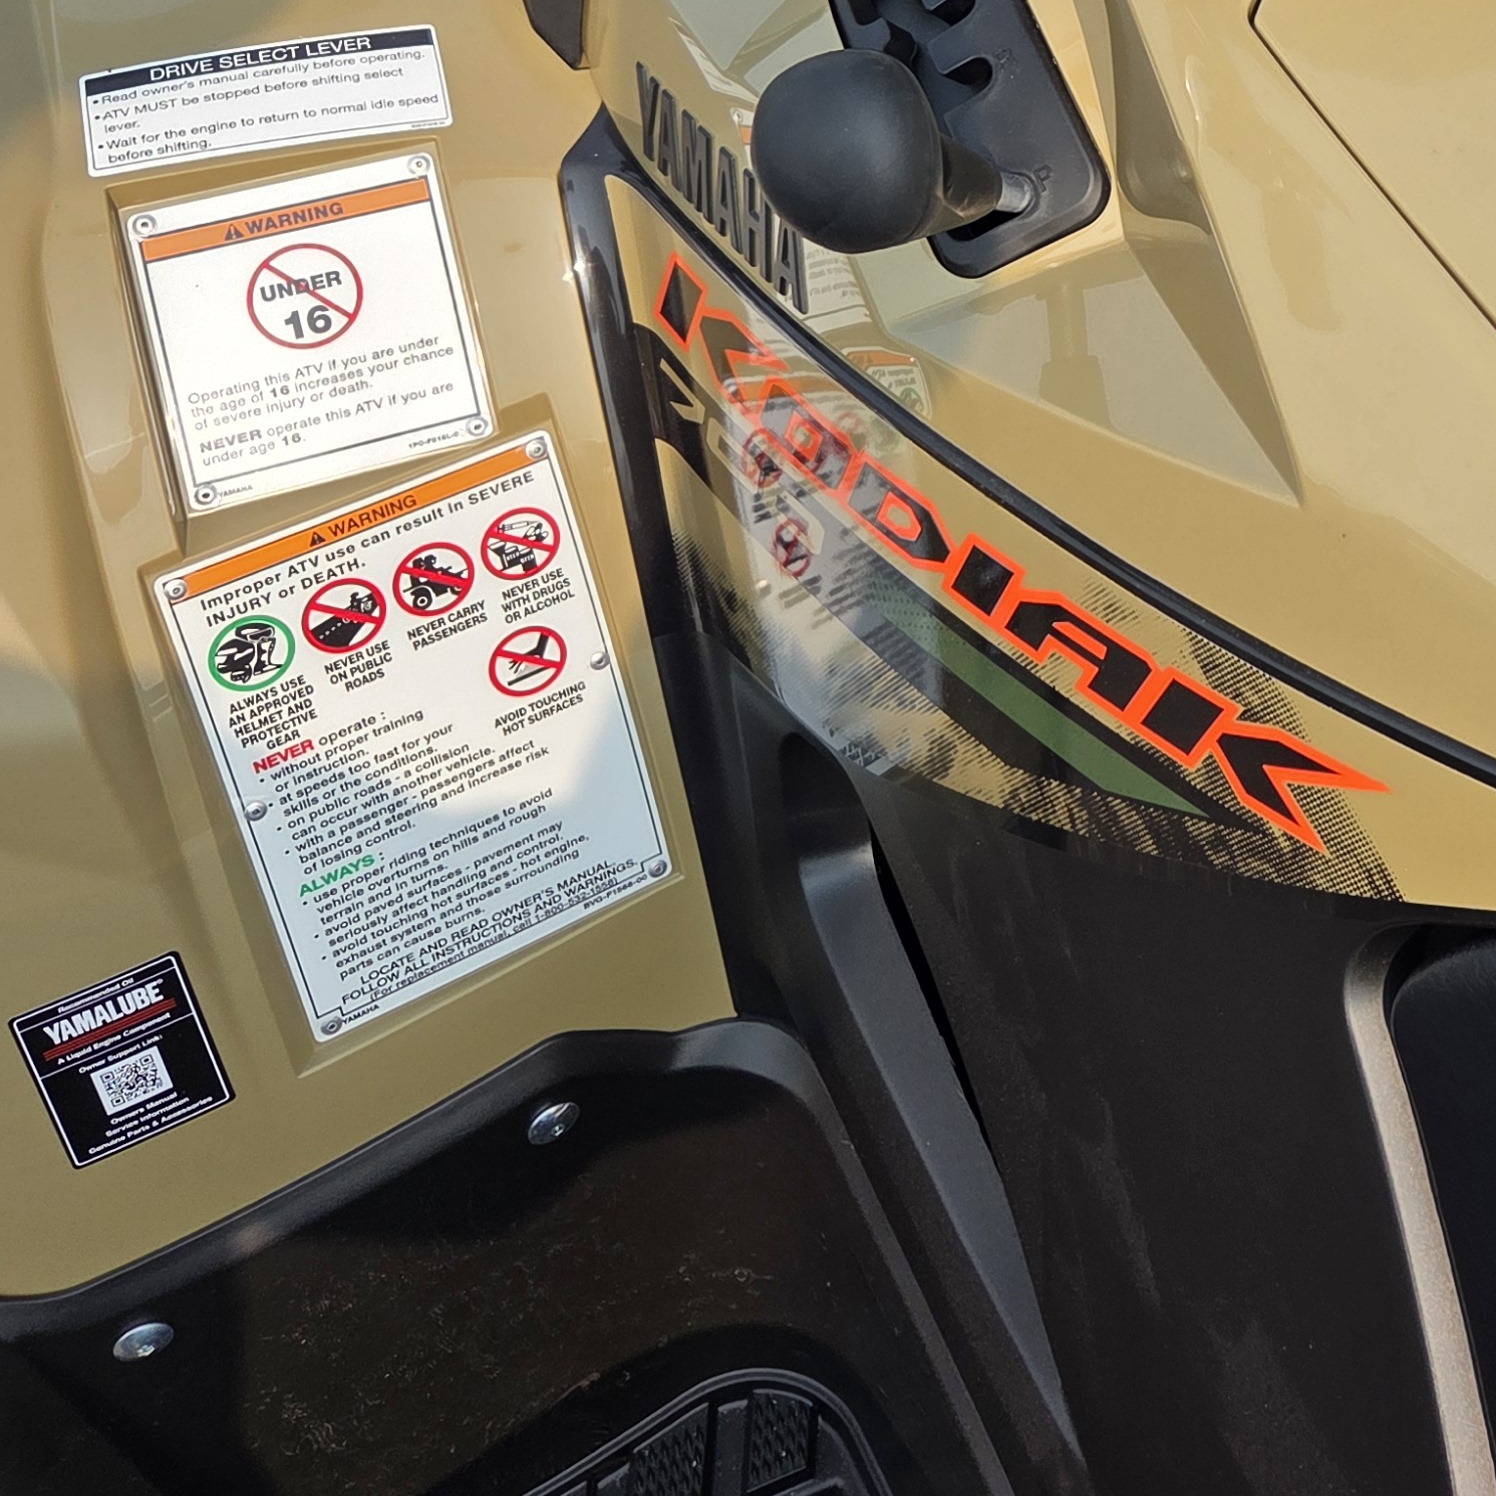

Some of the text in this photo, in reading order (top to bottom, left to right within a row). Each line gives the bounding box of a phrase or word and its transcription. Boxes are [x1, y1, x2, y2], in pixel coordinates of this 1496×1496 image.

[101, 50, 426, 105] Read owner's manual carefully before operating.
[150, 36, 372, 81] DRIVE SELECT LEVER
[102, 67, 404, 121] ATV MUST be stopped before shifting select
[104, 120, 141, 134] lever.
[106, 93, 439, 150] Wait for the engine to return to normal idle speed
[108, 139, 212, 164] before shifting.
[636, 60, 810, 315] YAMAHA
[1032, 164, 1053, 193] P
[244, 202, 344, 235] WARNING
[259, 270, 343, 302] UNDER
[284, 304, 333, 340] 16
[187, 336, 439, 405] Operating this ATV if you are under
[190, 346, 454, 418] the age of 16 increases your chance
[194, 379, 373, 431] of severe injury or death.
[199, 382, 454, 454] NEVER operate this ATV if you are
[202, 432, 306, 467] under age 16.
[214, 484, 254, 500] YAMAHA
[327, 494, 418, 538] WARNING
[200, 470, 535, 612] Improper ATV use can result in SEVERE
[652, 249, 1396, 858] KODIAK
[206, 557, 366, 628] INJURY or DEATH.
[501, 567, 565, 601] NEVER USE
[501, 577, 571, 613] WITH DRUGS
[406, 599, 485, 641] NEVER CARRY
[504, 589, 576, 624] OR ALCOHOL
[412, 612, 488, 651] PASSENGERS
[324, 639, 391, 675] NEVER USE
[329, 652, 393, 685] ON PUBLIC
[230, 674, 307, 715] ALWAYS USE
[344, 667, 386, 693] ROADS
[229, 684, 315, 728] AN APPROVED
[233, 698, 313, 739] HELMET AND
[494, 681, 587, 729] AVOID TOUCHING
[502, 693, 584, 737] HOT SURFACES
[240, 708, 318, 749] PROTECTIVE
[252, 715, 377, 775] NEVER operate
[266, 729, 301, 751] GEAR
[299, 854, 376, 898] ALWAYS
[360, 860, 616, 985] LOCATE AND READ OWNER'S MANUAL.
[42, 979, 165, 1045] YAMALUBE
